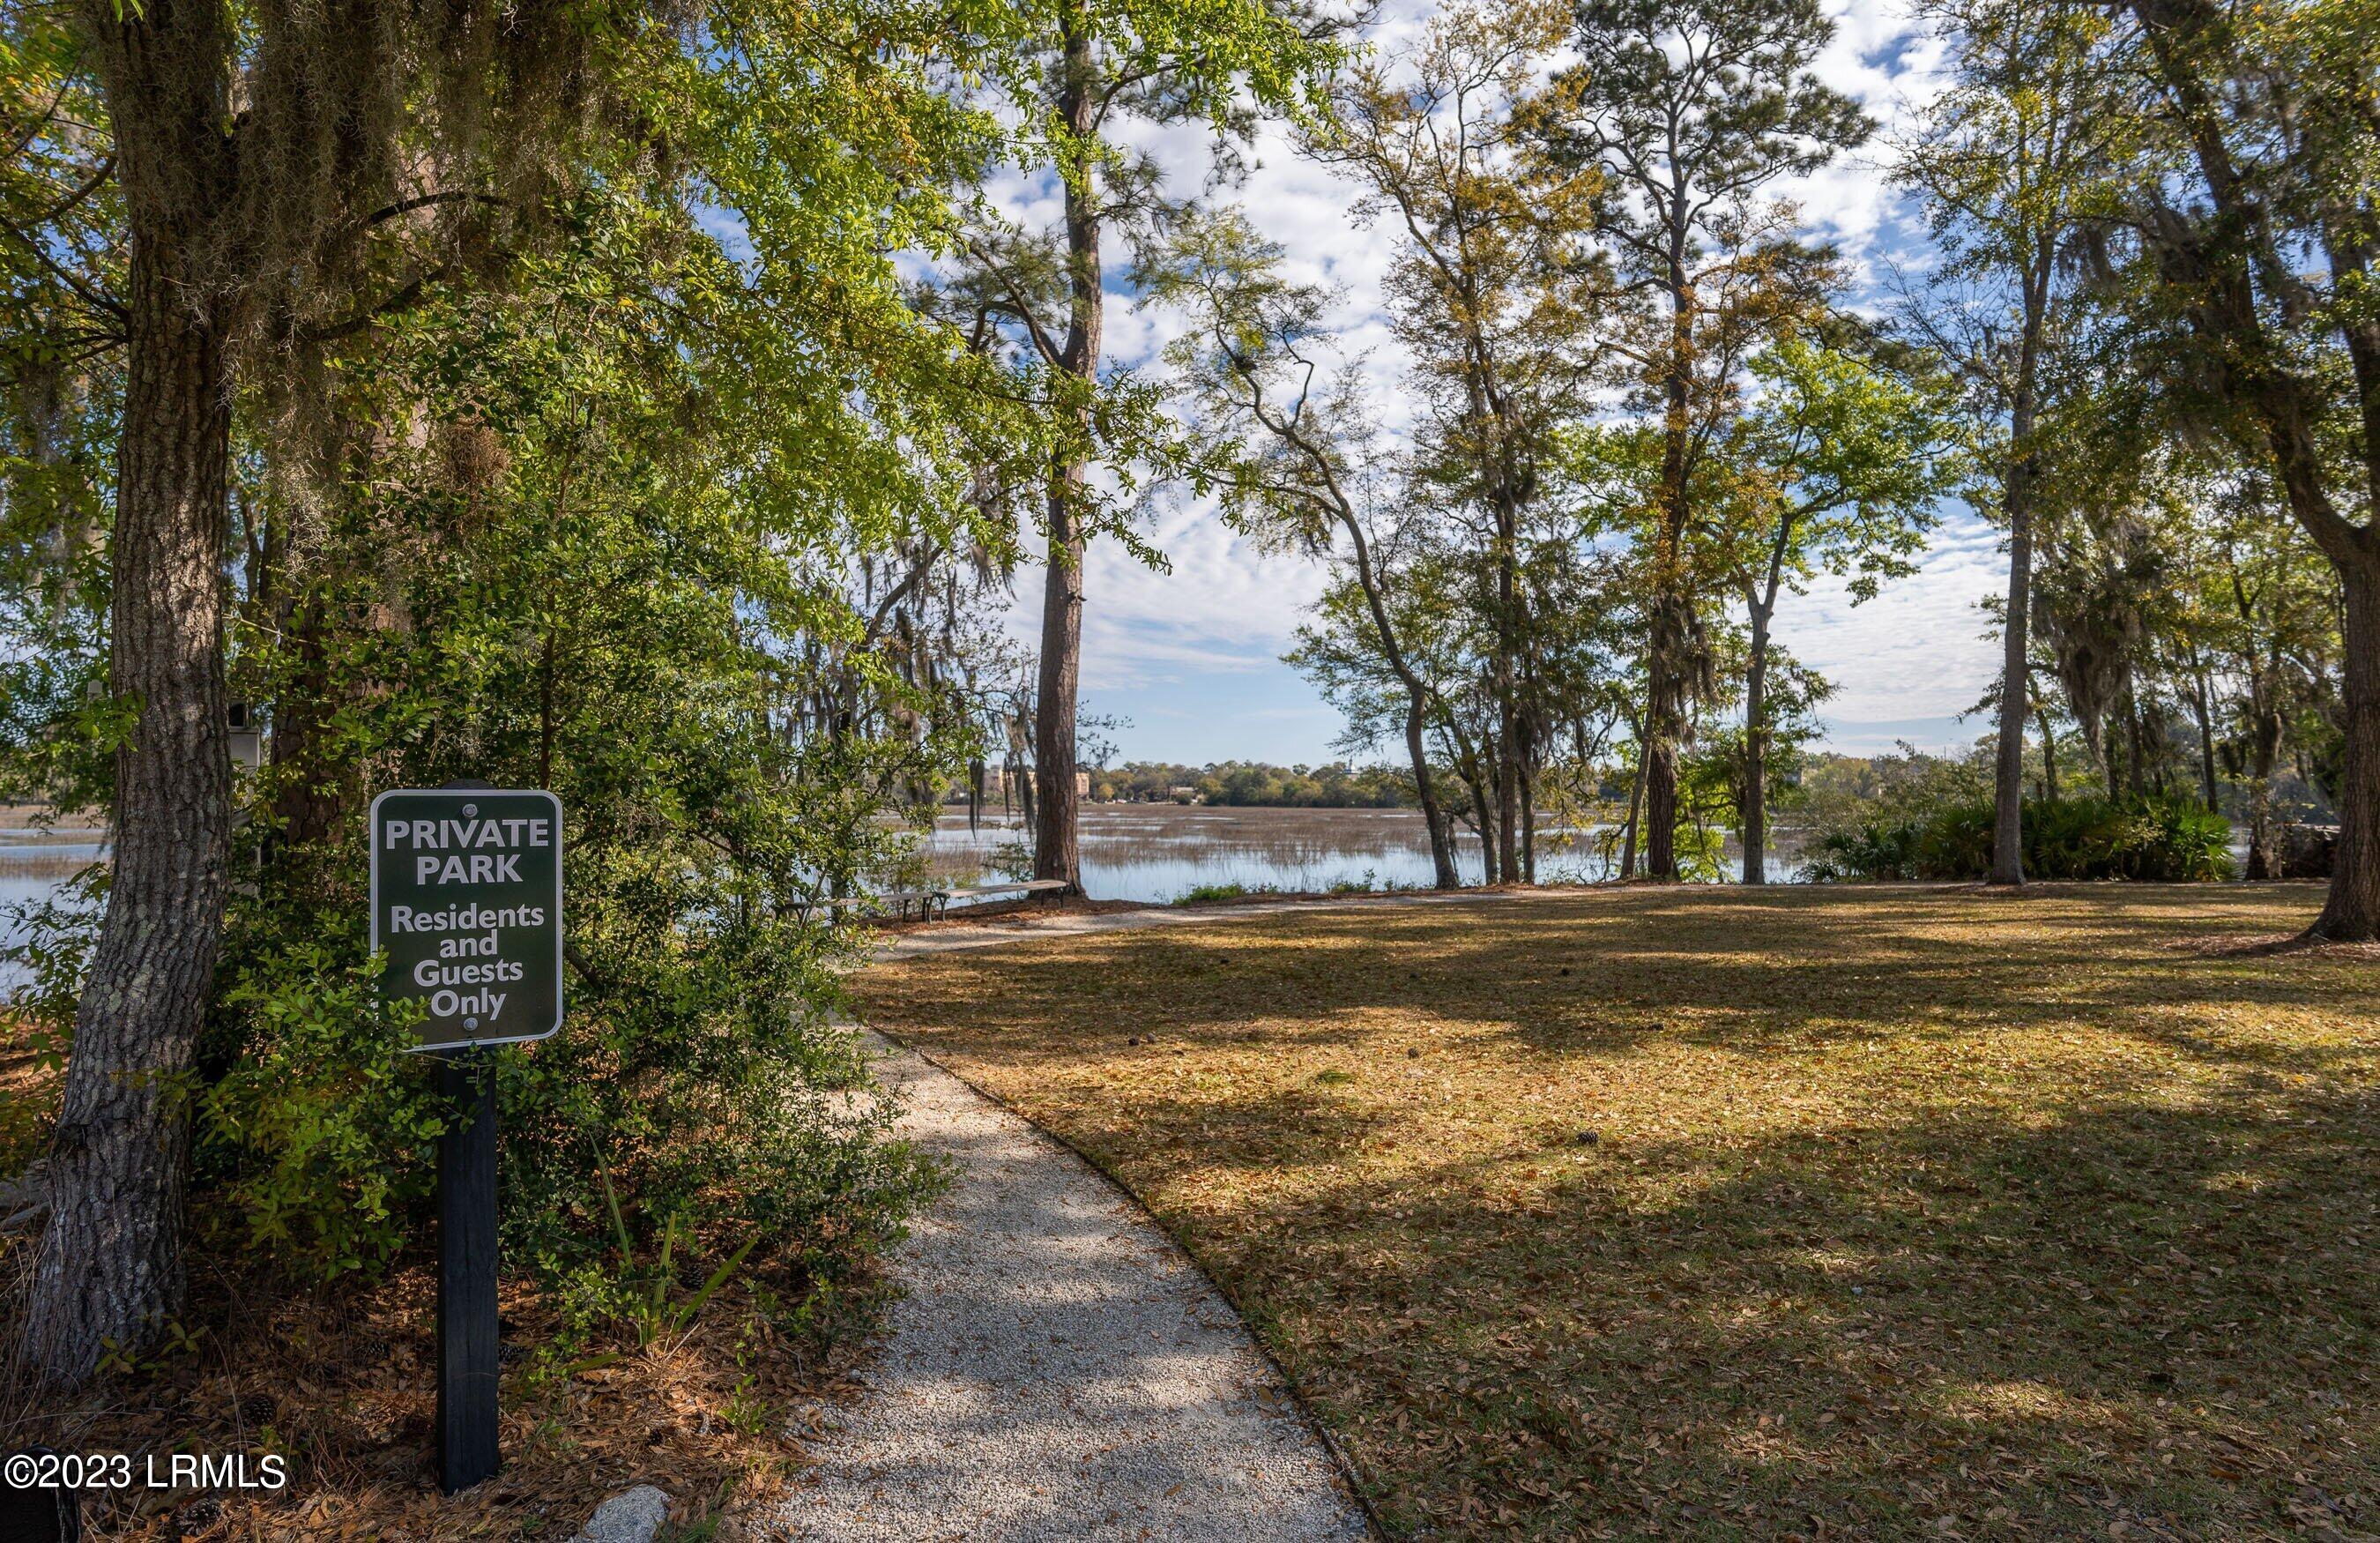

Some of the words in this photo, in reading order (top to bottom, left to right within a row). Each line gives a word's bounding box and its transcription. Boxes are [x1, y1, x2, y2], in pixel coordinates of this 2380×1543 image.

[385, 818, 549, 850] PRIVATE
[416, 853, 524, 885] PARK
[390, 902, 545, 933] Residents
[439, 928, 498, 958] and
[413, 958, 524, 987] Guests
[430, 987, 507, 1021] Only
